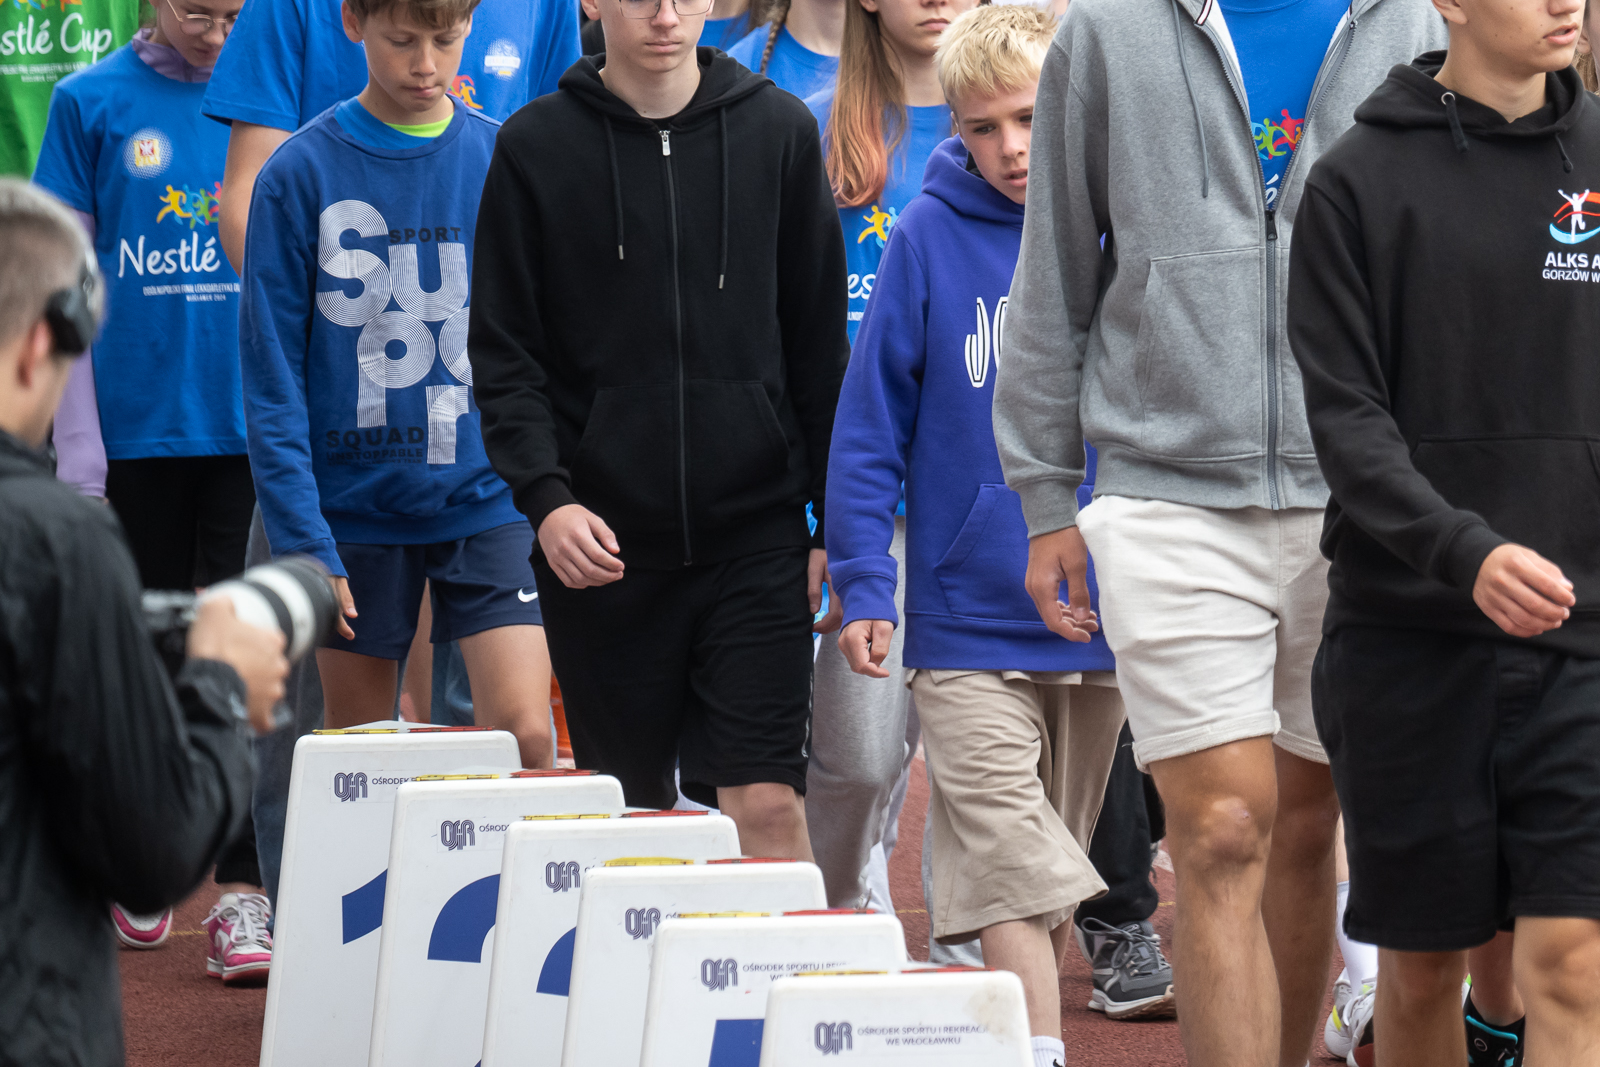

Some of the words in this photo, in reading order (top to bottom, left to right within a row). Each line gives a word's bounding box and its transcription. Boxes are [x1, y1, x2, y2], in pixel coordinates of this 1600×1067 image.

[0, 14, 53, 56] stlé
[60, 12, 112, 65] Cup
[388, 226, 461, 244] SPORT
[118, 230, 221, 278] Nestlé
[1544, 251, 1589, 268] ALKS
[1542, 267, 1590, 282] GORZÓW
[326, 426, 424, 451] SQUAD
[326, 448, 423, 461] UNSTOPPABLE
[479, 824, 509, 832] OŚROD
[742, 962, 784, 972] OŚRODEK
[786, 962, 820, 972] SPORTU
[857, 1025, 900, 1036] OŚRODEK
[902, 1026, 937, 1035] SPORTU
[885, 1038, 900, 1046] WE
[902, 1037, 961, 1046] WŁOCŁAWKU
